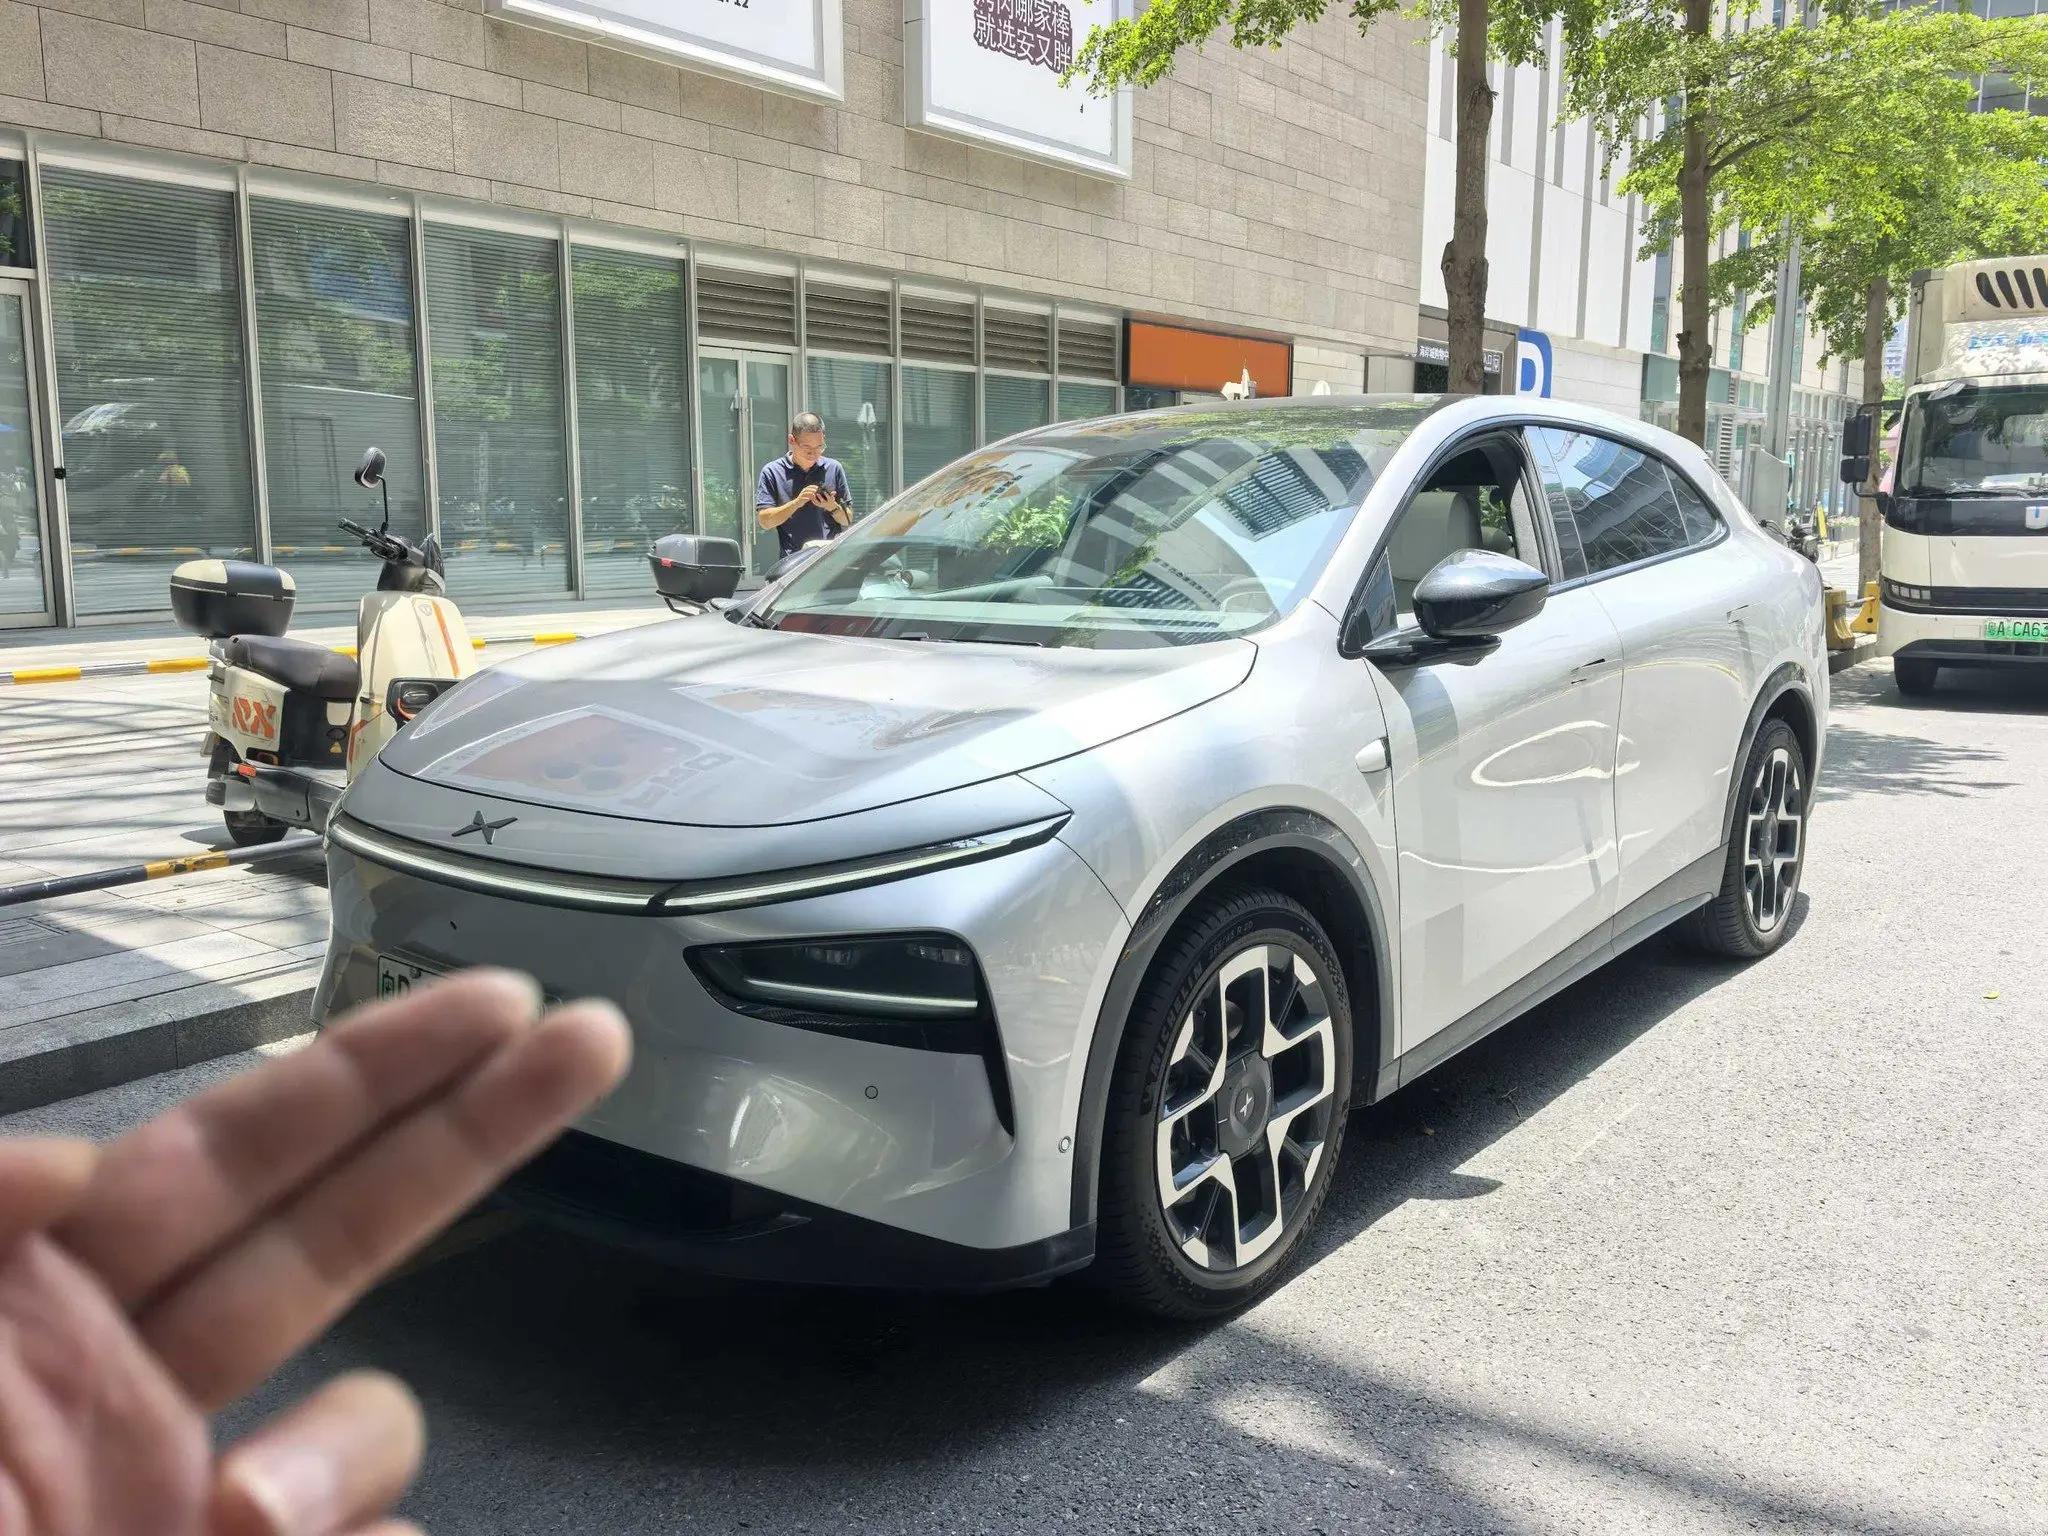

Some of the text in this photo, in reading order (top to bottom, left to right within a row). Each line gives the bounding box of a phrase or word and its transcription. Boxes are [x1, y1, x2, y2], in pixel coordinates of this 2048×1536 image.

[975, 13, 1072, 74] 就选安又胖
